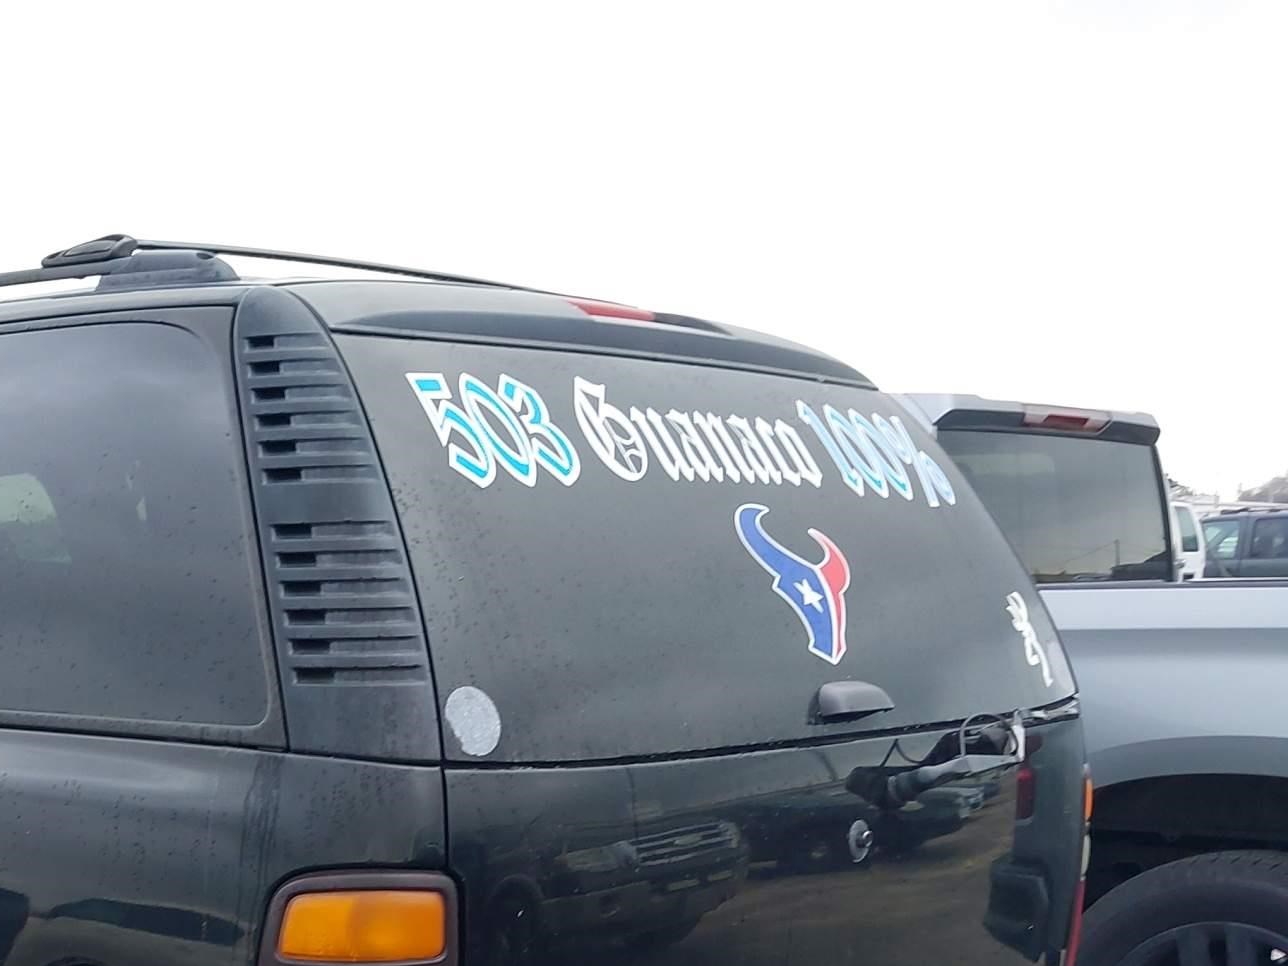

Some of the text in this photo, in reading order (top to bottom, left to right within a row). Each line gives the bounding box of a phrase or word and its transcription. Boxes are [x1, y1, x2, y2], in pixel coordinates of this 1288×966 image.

[405, 372, 956, 508] 503 Guanaco 100%
